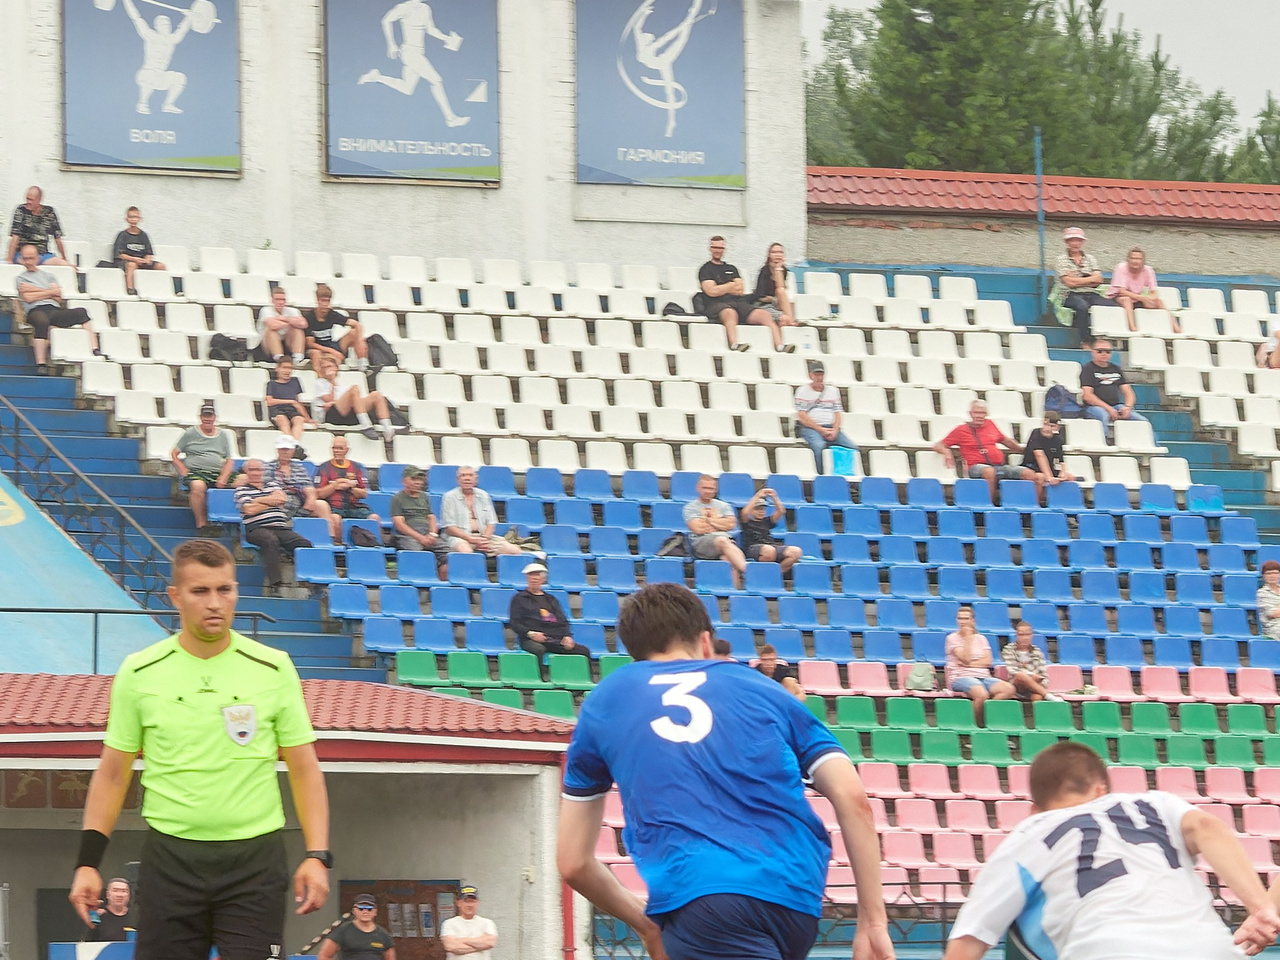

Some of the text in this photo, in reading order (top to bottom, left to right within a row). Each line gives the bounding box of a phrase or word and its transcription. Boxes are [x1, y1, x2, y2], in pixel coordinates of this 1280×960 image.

[338, 137, 493, 157] ВНИМАТЕЛЬНОСТЬ
[617, 147, 706, 165] ГАРМОНИЯ
[648, 671, 714, 744] 3
[1043, 799, 1182, 898] 24
